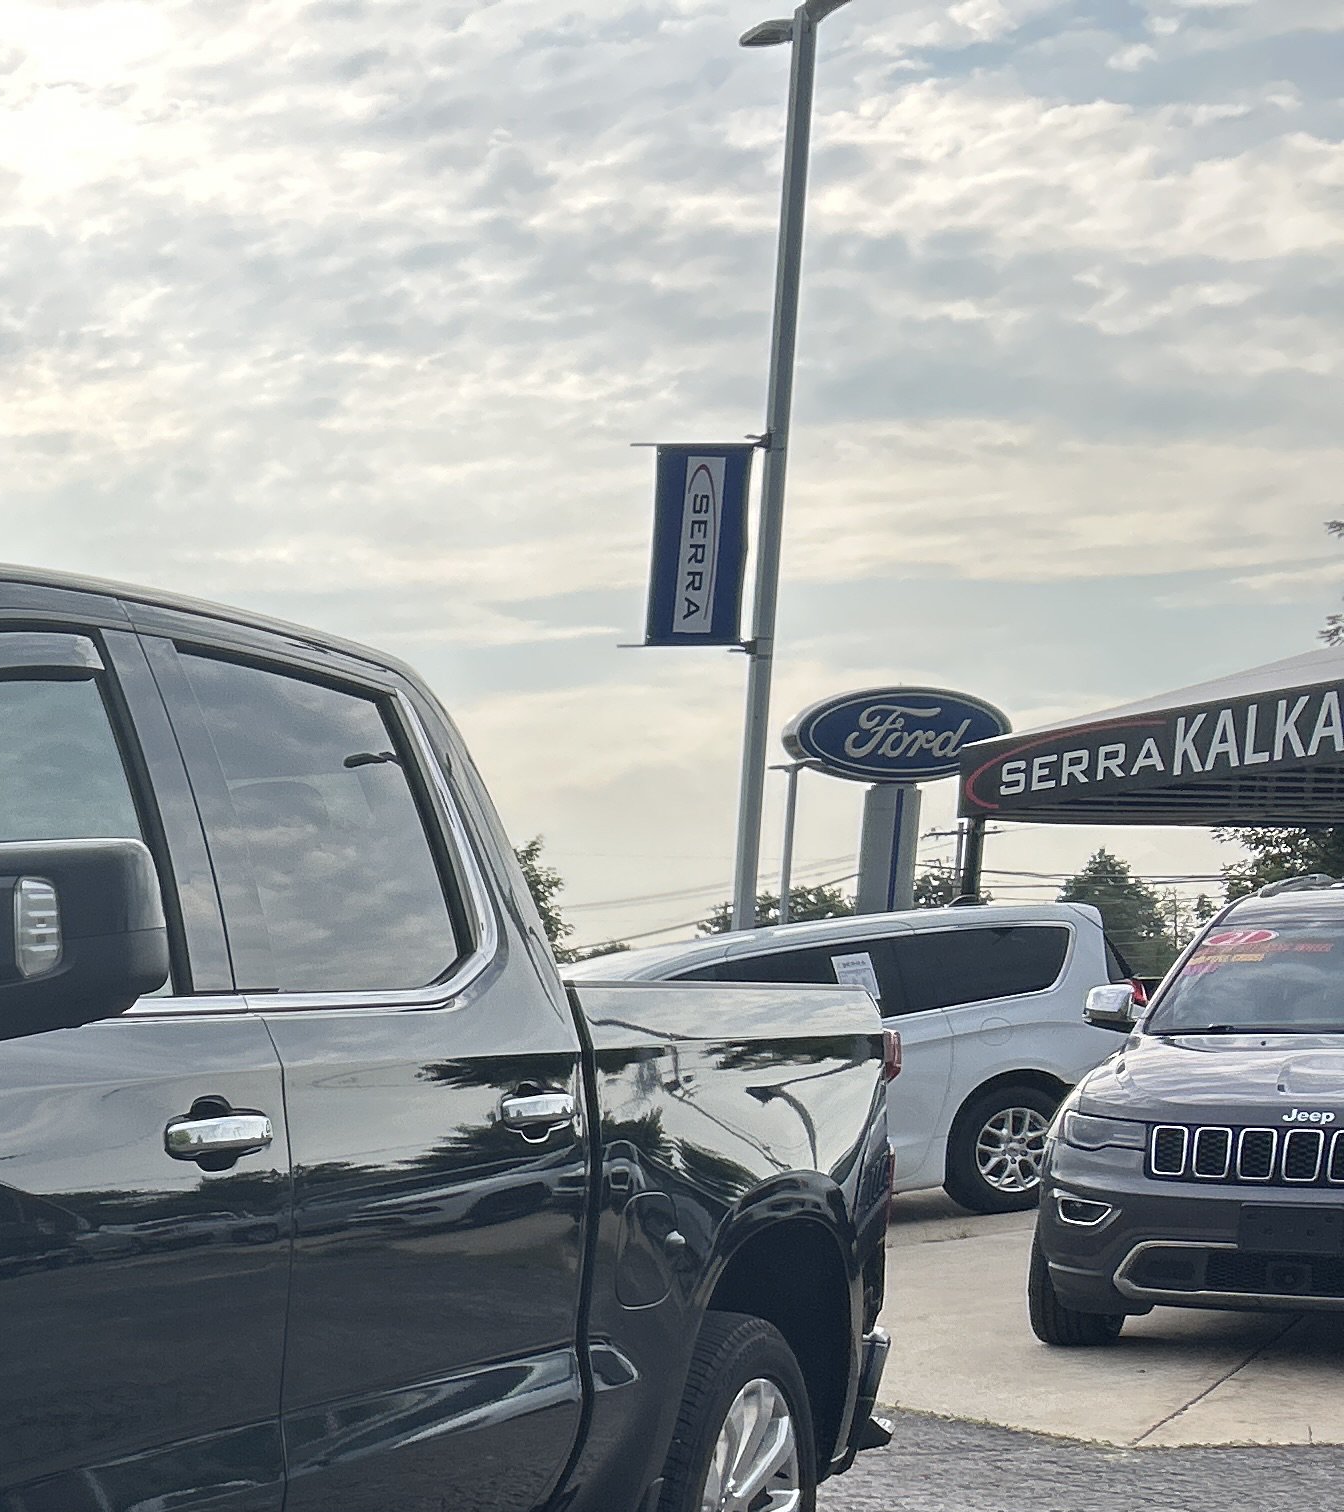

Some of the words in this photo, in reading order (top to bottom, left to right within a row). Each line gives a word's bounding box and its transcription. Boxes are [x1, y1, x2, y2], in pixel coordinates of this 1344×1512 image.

[682, 492, 710, 621] SERRA
[843, 703, 972, 759] Ford
[999, 736, 1166, 797] SERRA
[1172, 690, 1344, 776] KALKA
[1282, 1108, 1336, 1125] Jeep
